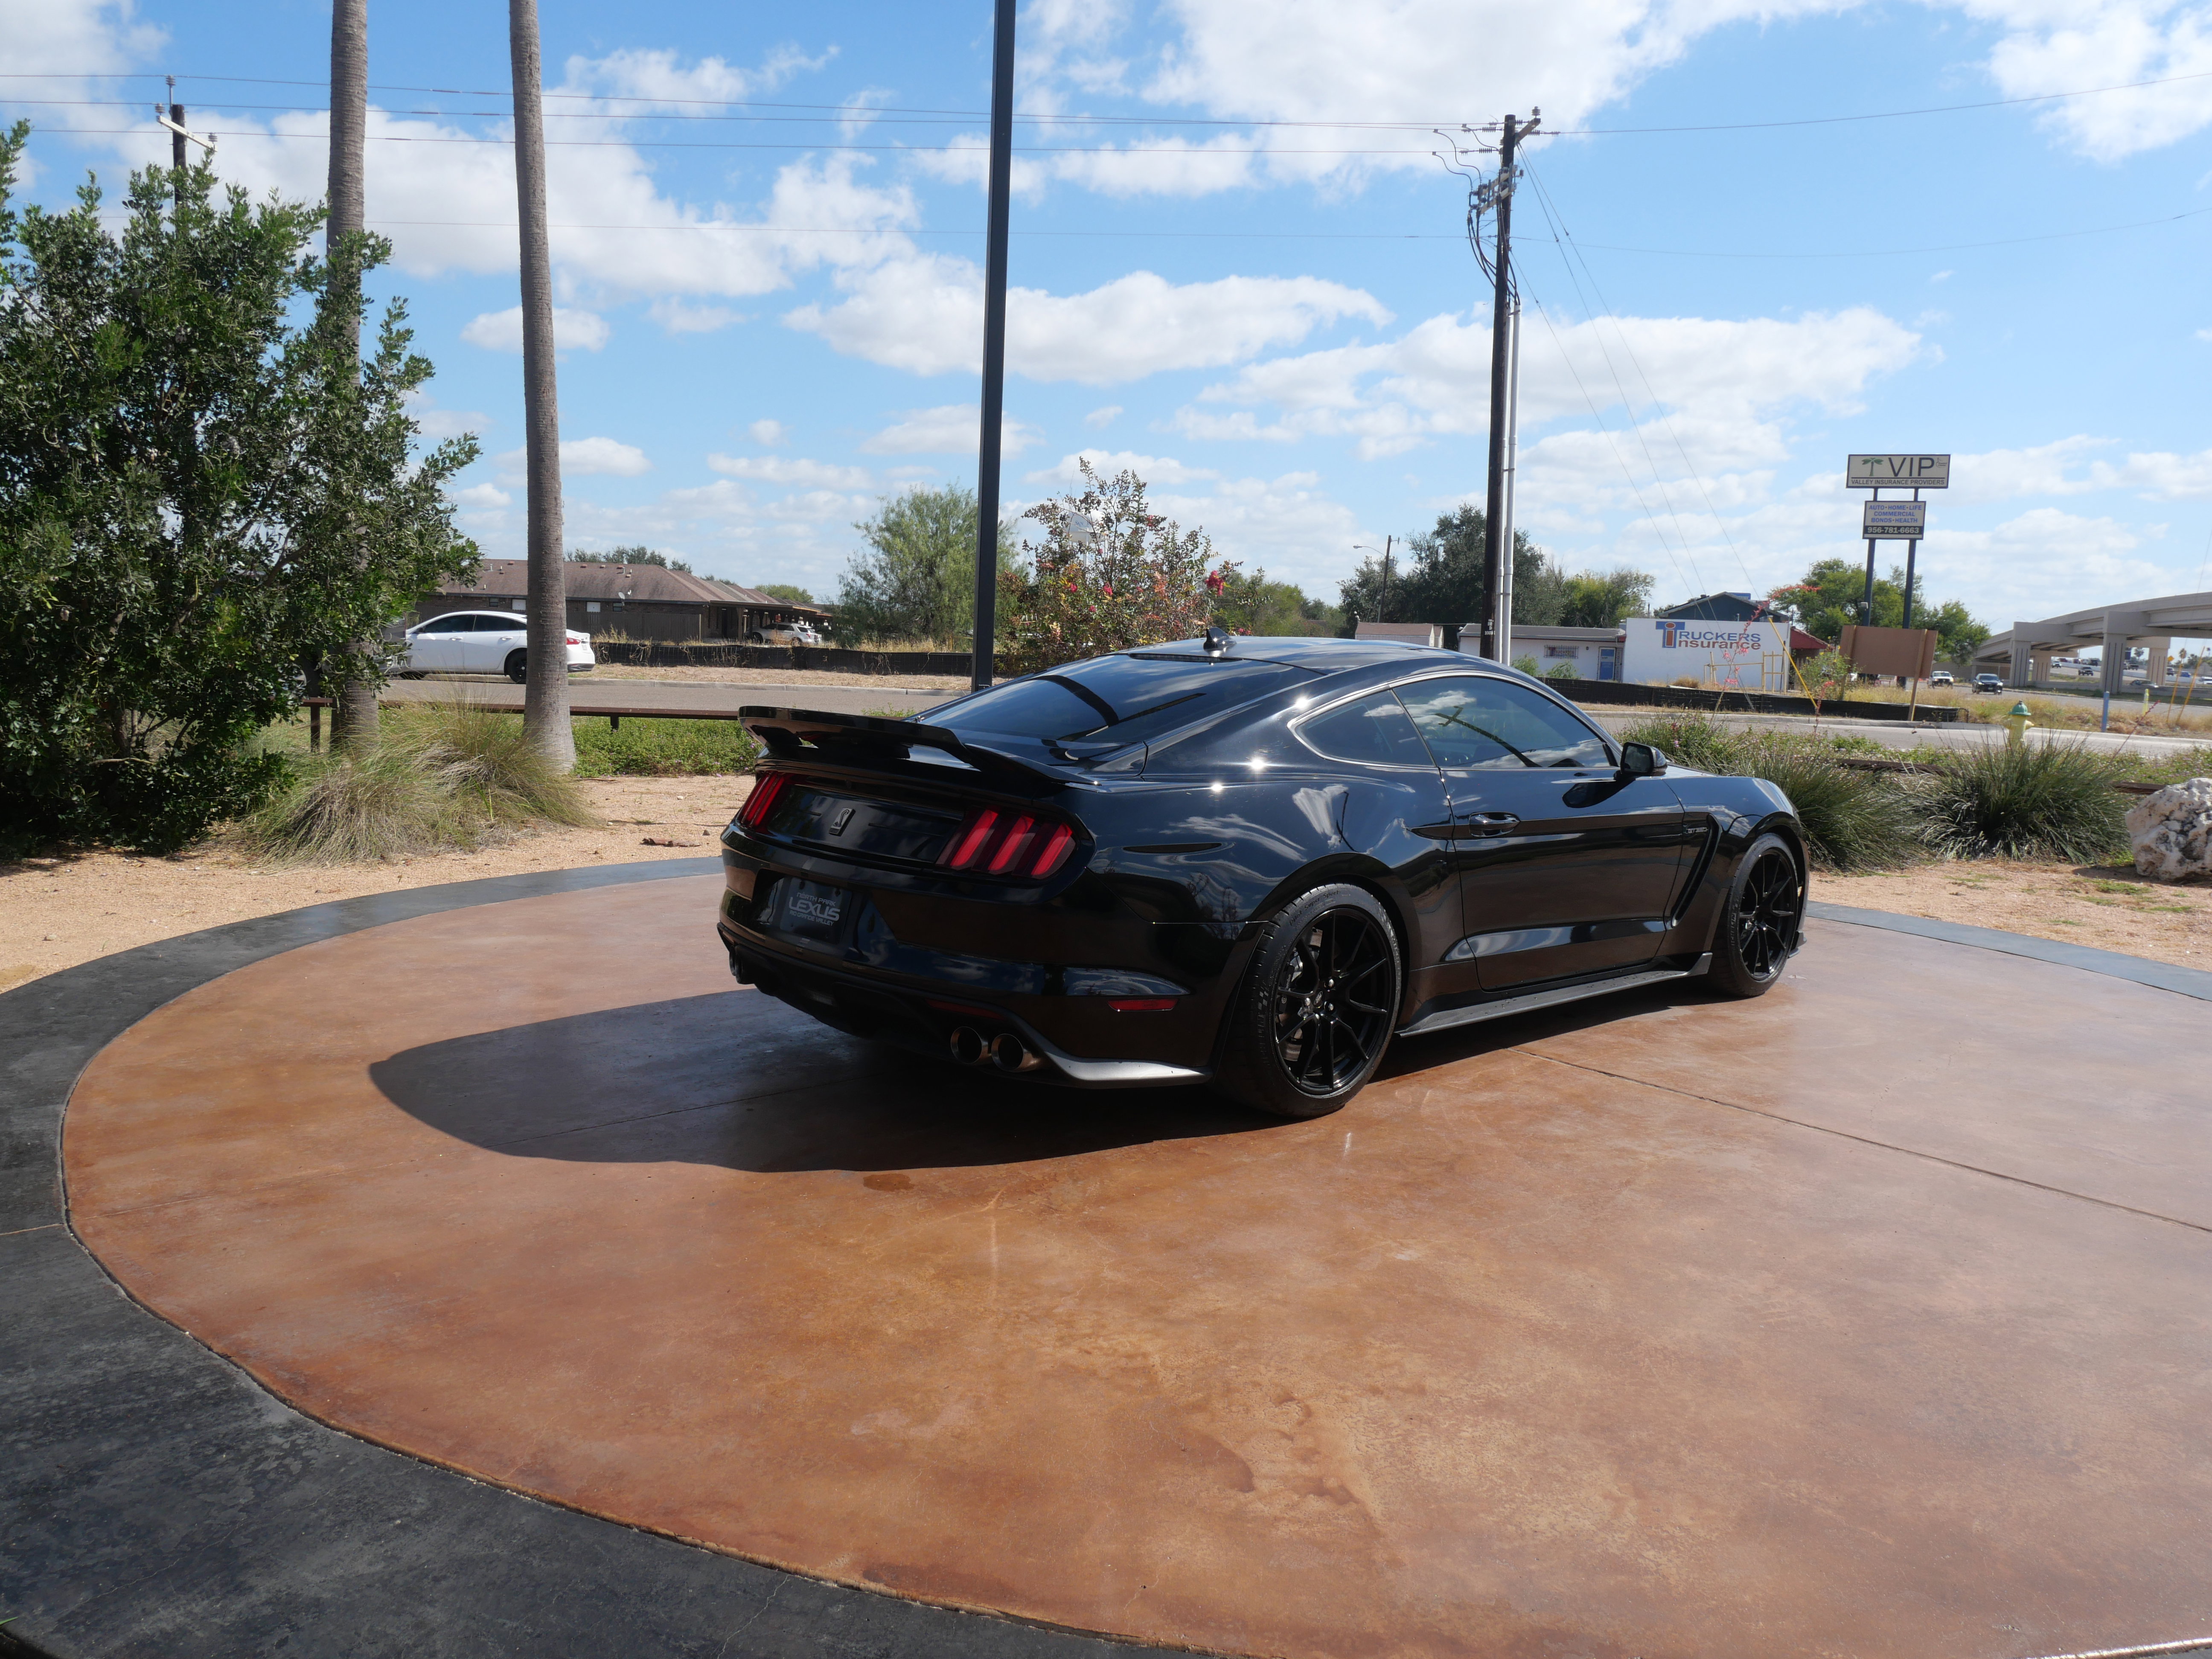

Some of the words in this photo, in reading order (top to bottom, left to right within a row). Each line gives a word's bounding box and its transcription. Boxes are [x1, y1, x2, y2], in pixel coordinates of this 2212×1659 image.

[1888, 457, 1935, 477] VIP
[1323, 890, 1339, 899] Sport
[818, 897, 836, 907] PARK
[789, 896, 841, 921] LEXUS
[816, 916, 834, 926] VALLEY
